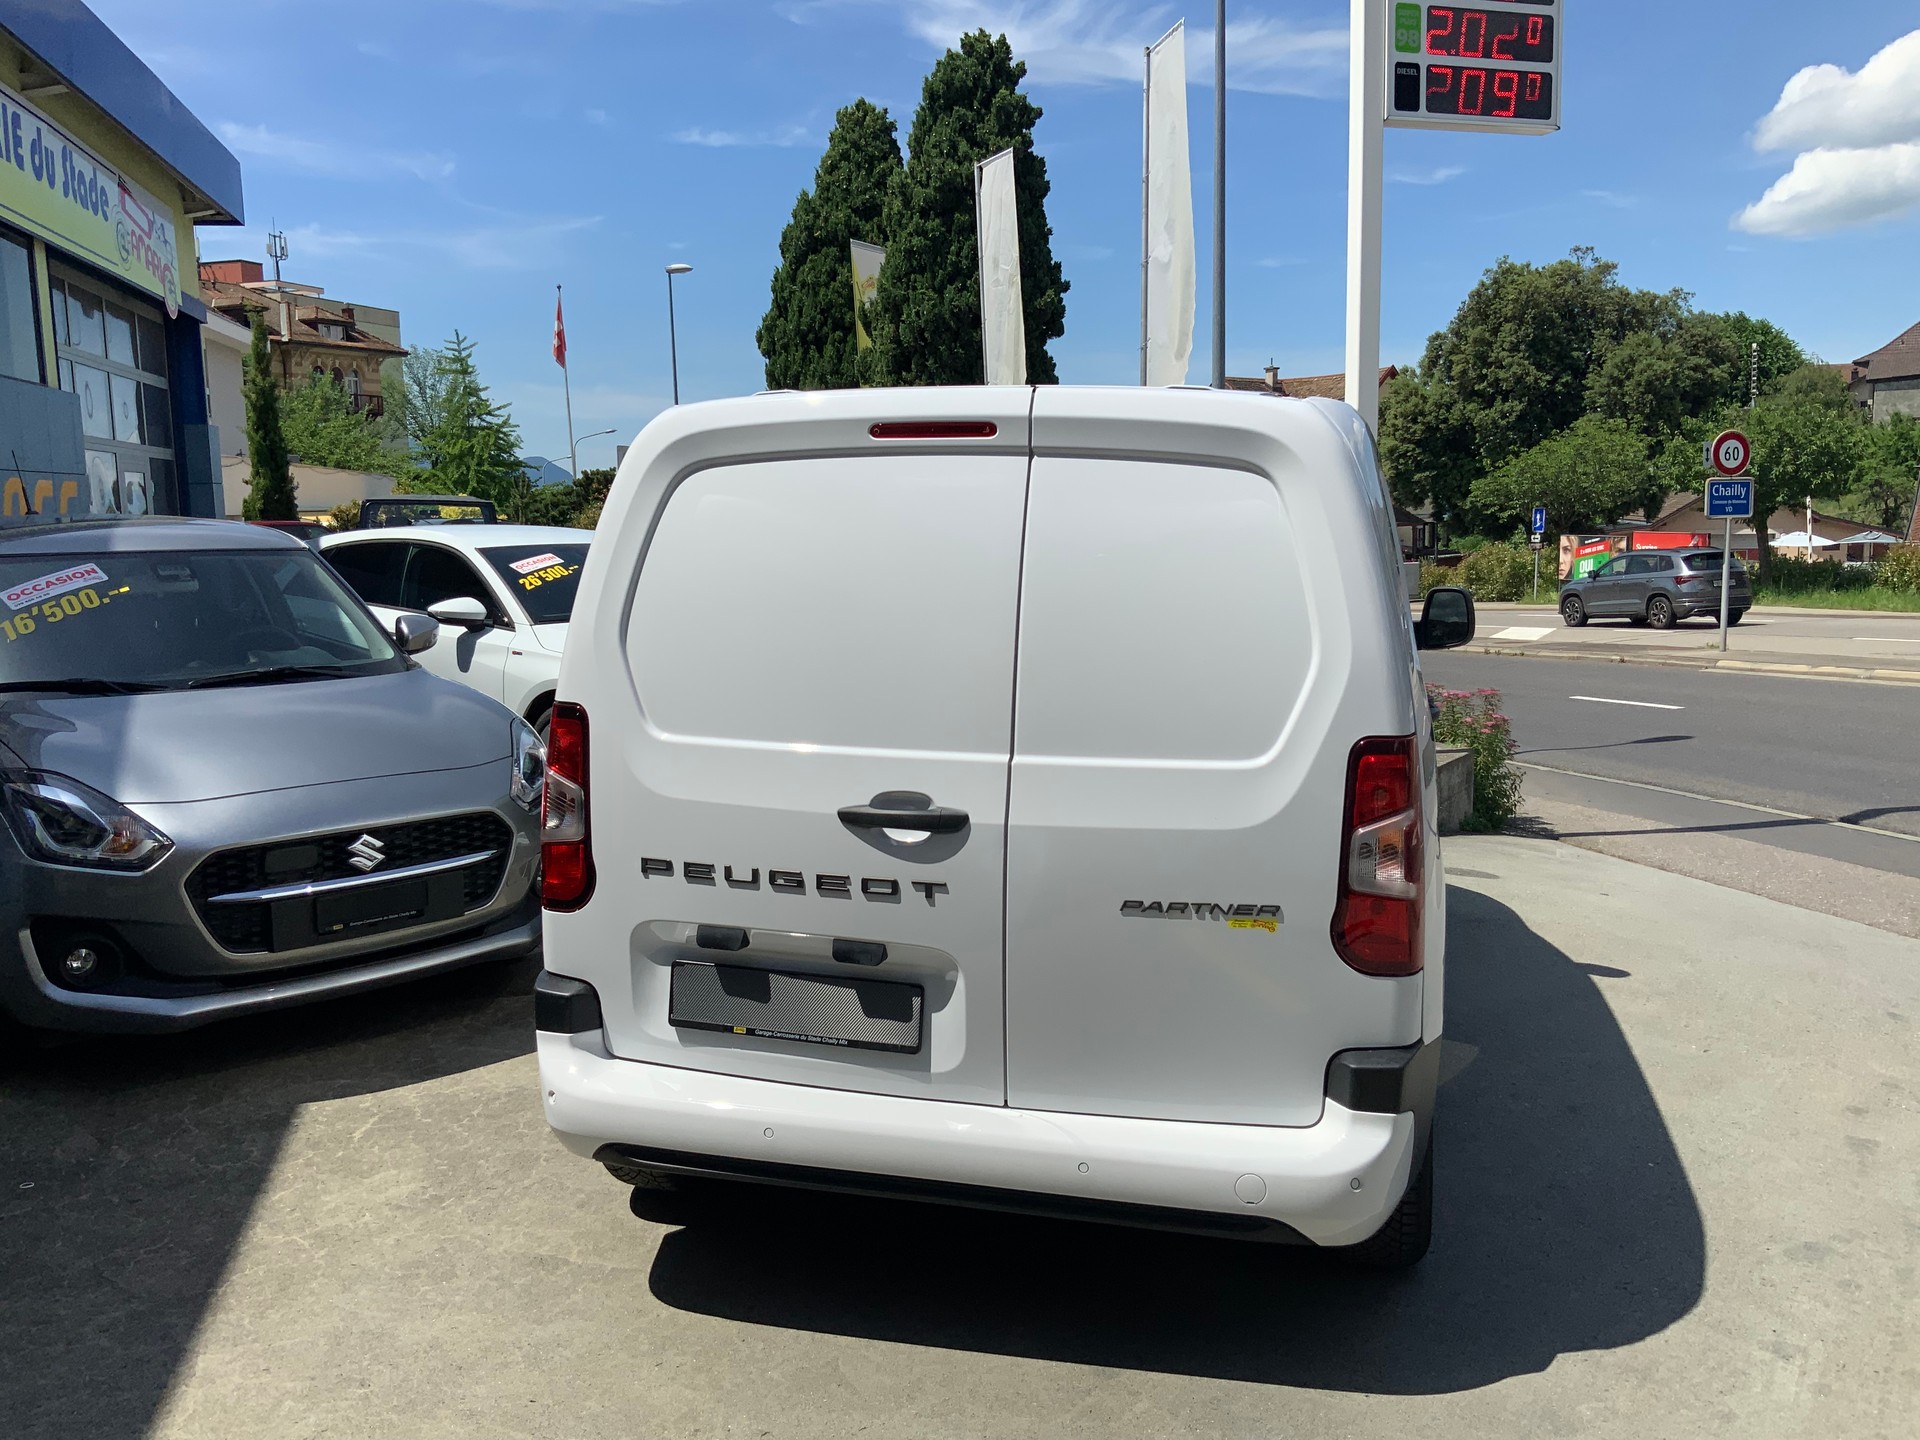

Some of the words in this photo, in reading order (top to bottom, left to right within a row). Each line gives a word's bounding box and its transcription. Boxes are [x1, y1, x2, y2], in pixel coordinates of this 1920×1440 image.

[1397, 67, 1418, 76] DIESEL
[0, 102, 25, 172] IE
[30, 126, 56, 190] du
[61, 144, 109, 222] Stade
[1723, 446, 1740, 462] 60
[1712, 484, 1747, 499] Chailly
[515, 555, 557, 570] OCCASION
[1579, 557, 1594, 574] OUI
[6, 566, 99, 602] OCCASION
[640, 857, 948, 902] PEUGEOT
[1120, 899, 1283, 920] PARTNER
[822, 1036, 838, 1045] Chailly
